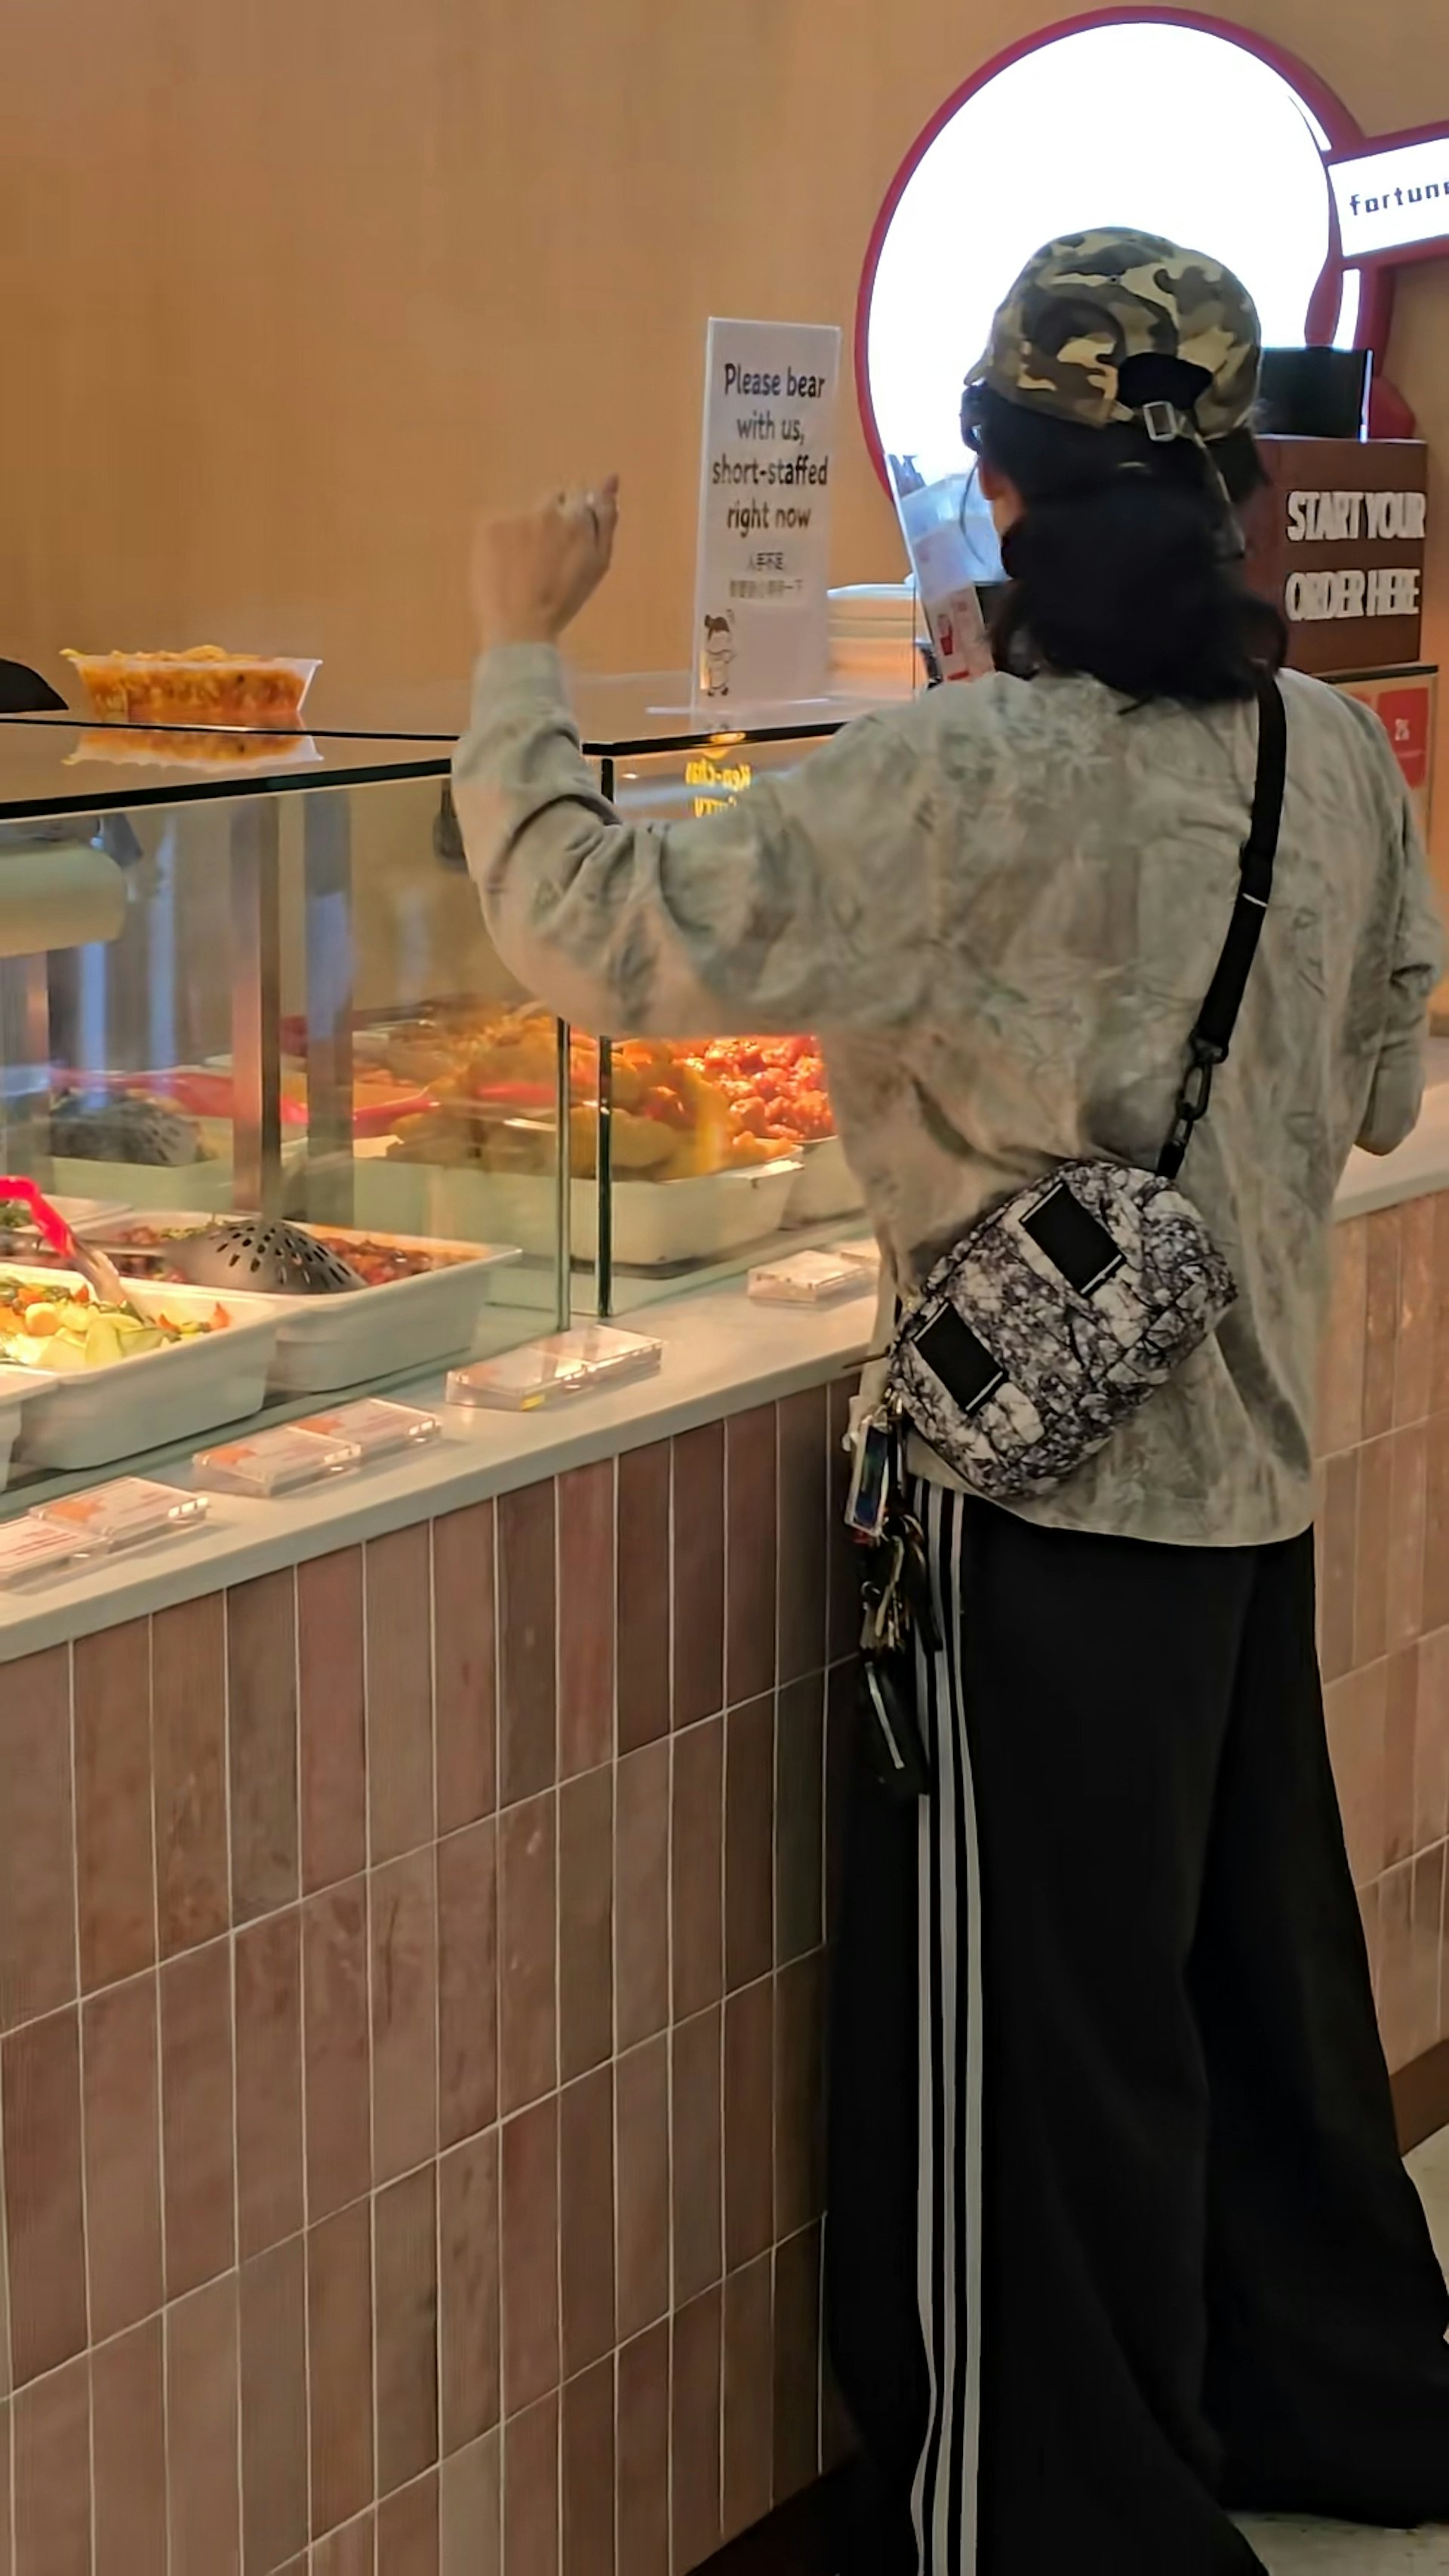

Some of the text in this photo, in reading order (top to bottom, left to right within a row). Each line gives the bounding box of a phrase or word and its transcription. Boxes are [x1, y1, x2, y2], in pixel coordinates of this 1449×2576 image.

[724, 362, 826, 399] Please bear
[737, 409, 805, 446] with us,
[712, 452, 829, 485] short-staffed
[727, 498, 812, 538] right now
[1287, 491, 1426, 541] START YOUR
[1284, 568, 1421, 622] ORDER HERE
